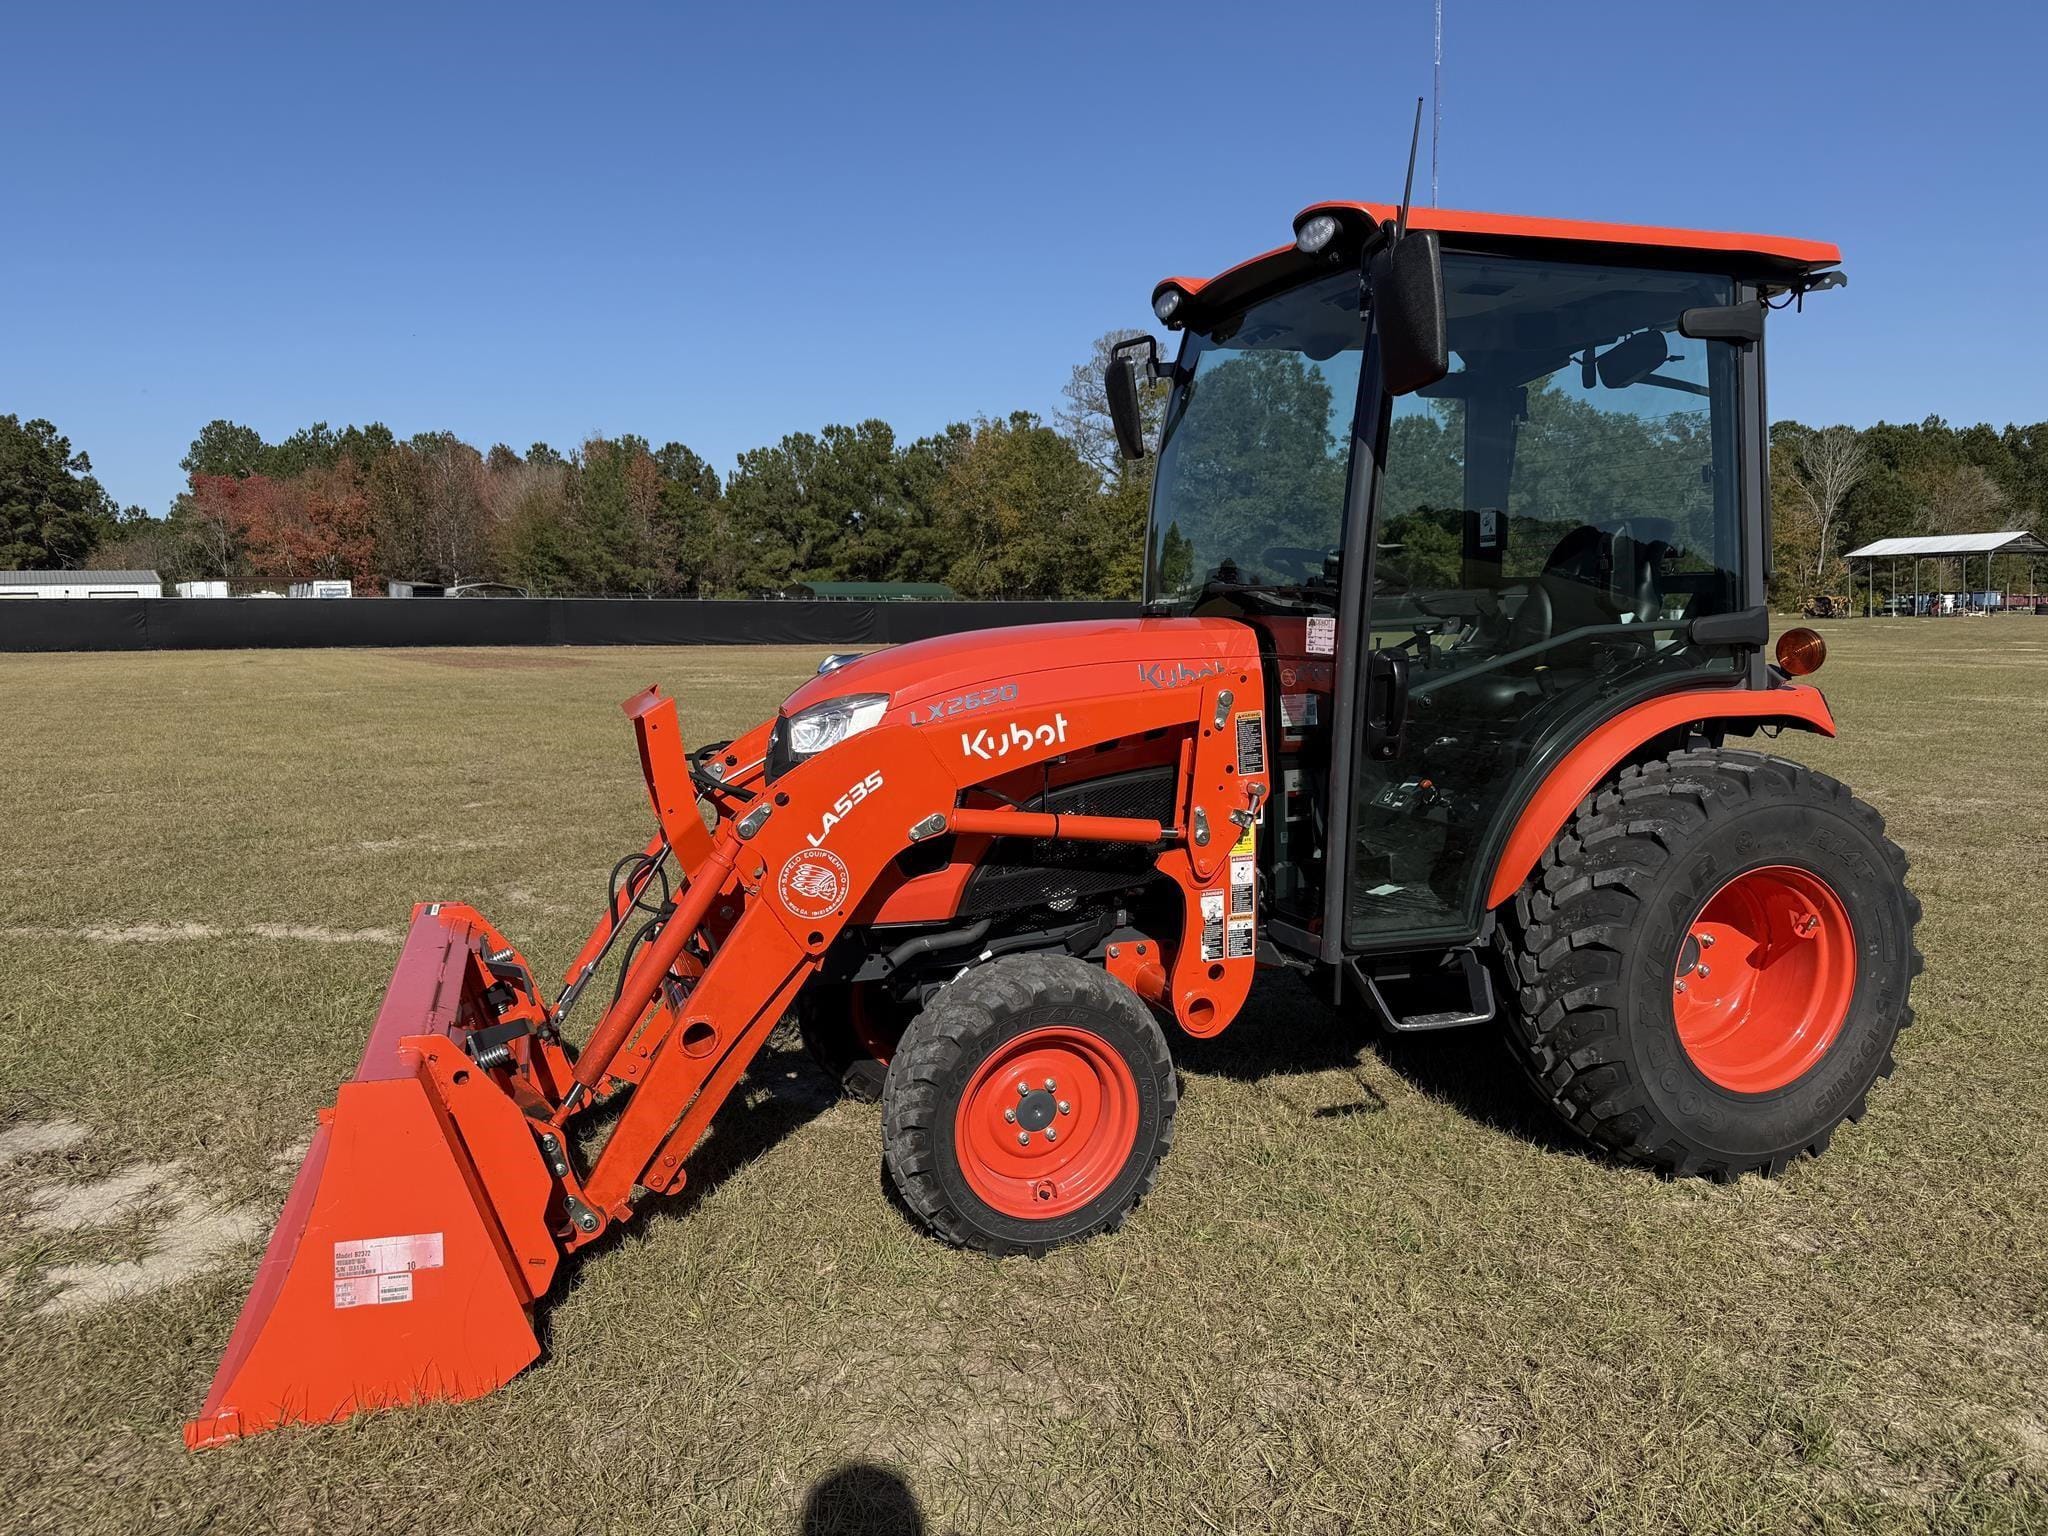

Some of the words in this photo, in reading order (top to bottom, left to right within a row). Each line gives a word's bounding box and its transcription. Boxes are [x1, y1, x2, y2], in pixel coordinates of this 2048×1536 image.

[910, 684, 1019, 728] LX2620
[806, 769, 884, 847] LA535
[781, 856, 802, 884] SAPELO
[336, 1251, 353, 1260] Model
[407, 1261, 416, 1270] 10
